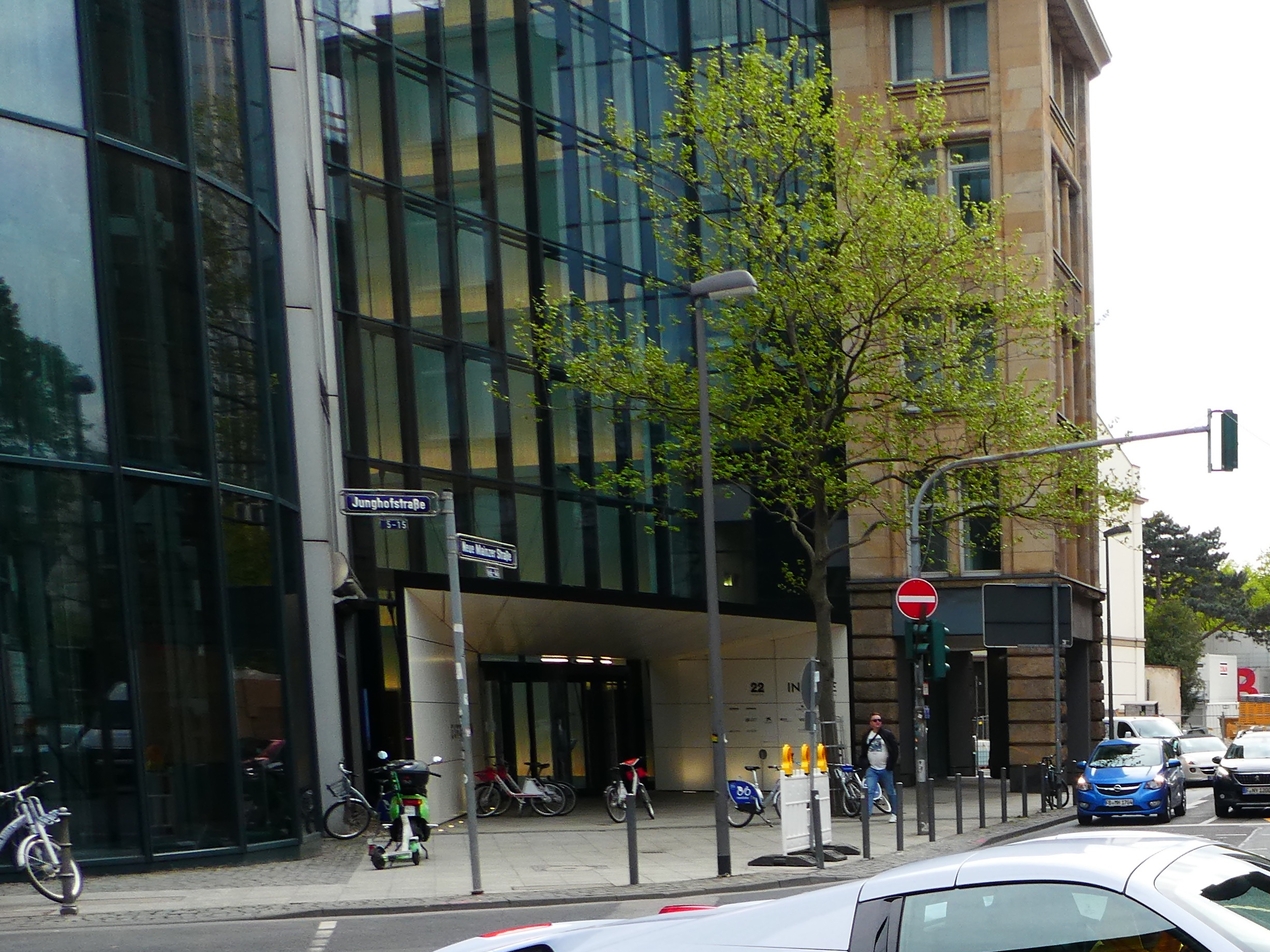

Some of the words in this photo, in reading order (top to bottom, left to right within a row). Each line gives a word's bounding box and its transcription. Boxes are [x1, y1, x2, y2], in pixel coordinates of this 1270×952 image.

[351, 496, 426, 511] Junghofstraße
[386, 520, 407, 529] 5-15
[461, 541, 475, 554] Neue
[475, 543, 496, 558] Mainzer
[750, 682, 765, 693] 22
